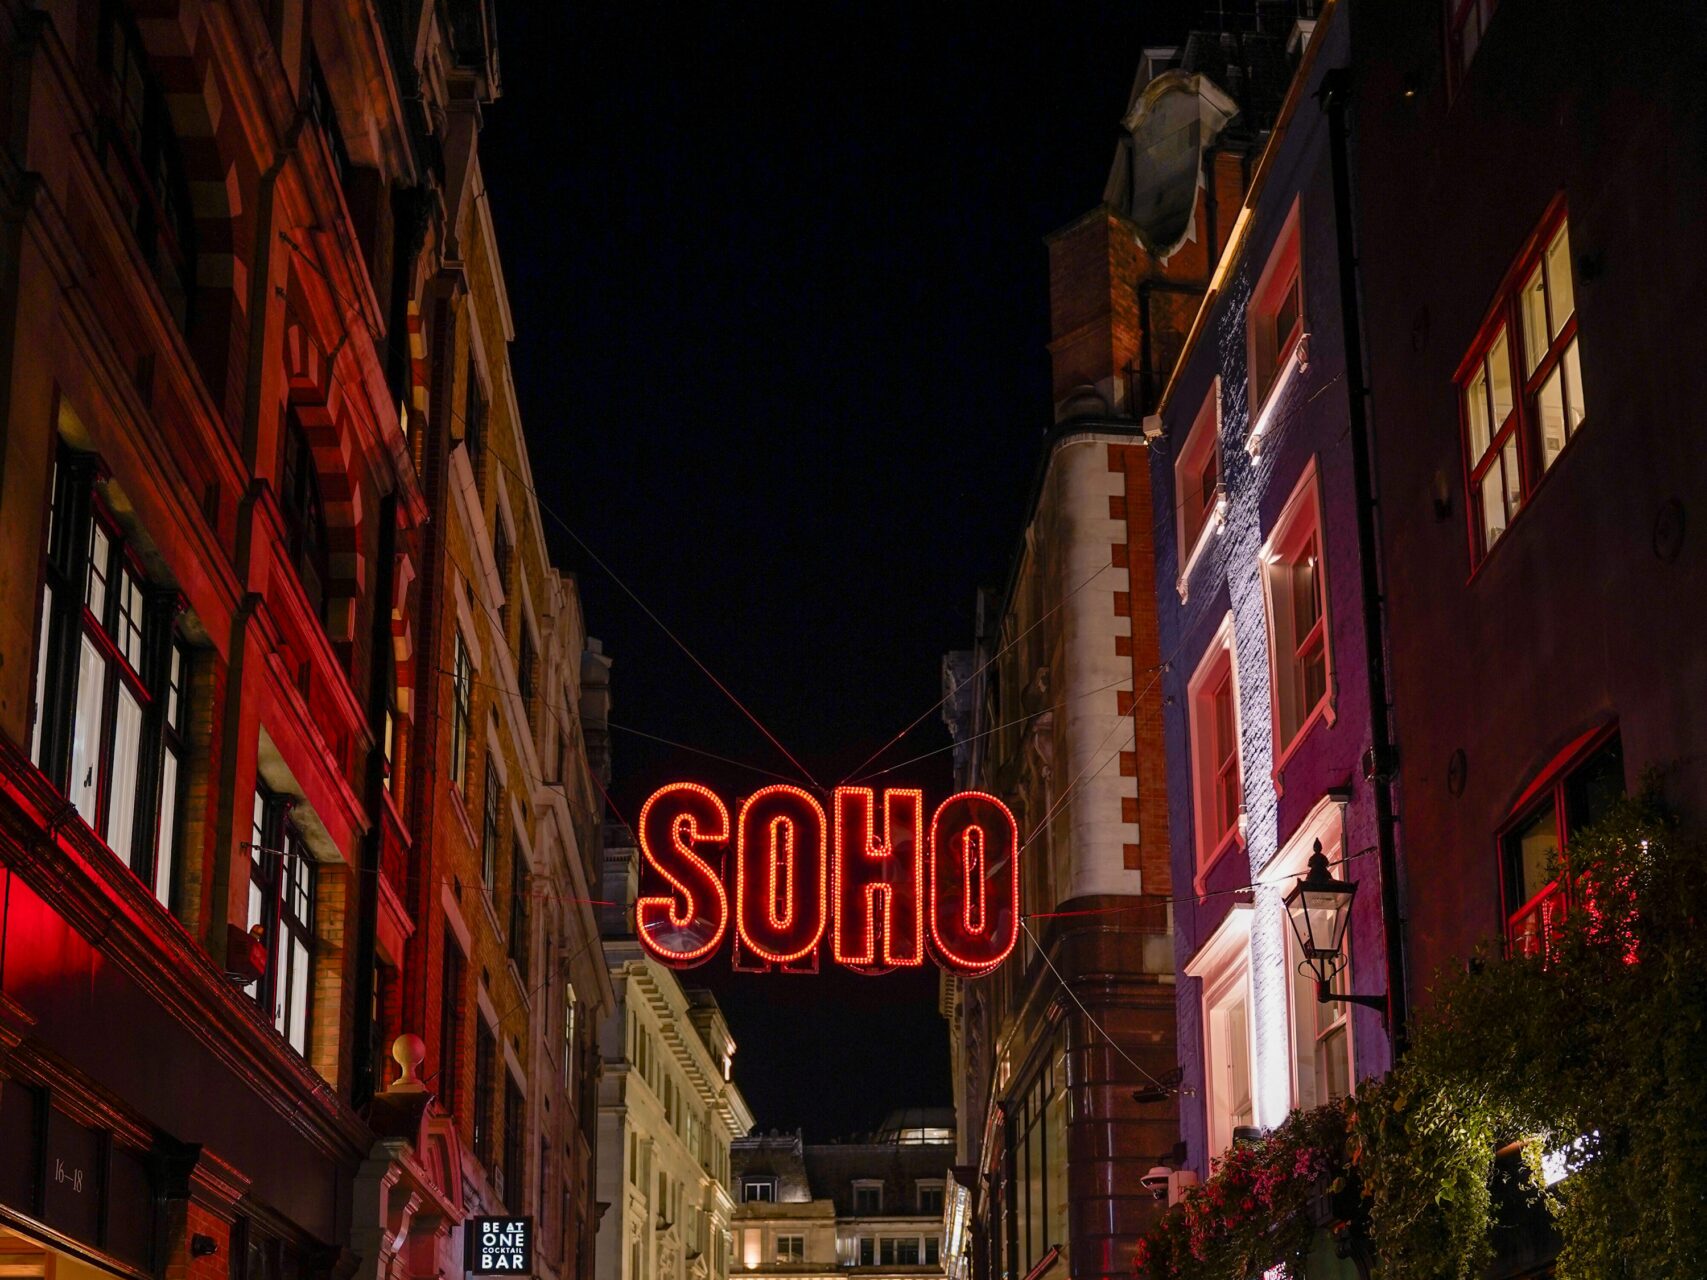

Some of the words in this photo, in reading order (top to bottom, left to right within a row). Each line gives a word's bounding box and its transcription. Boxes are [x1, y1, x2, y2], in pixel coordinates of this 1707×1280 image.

[637, 782, 1019, 969] SOHO
[482, 1222, 500, 1233] BE
[506, 1222, 524, 1233] AT
[482, 1233, 524, 1247] ONE
[481, 1254, 524, 1270] BAR
